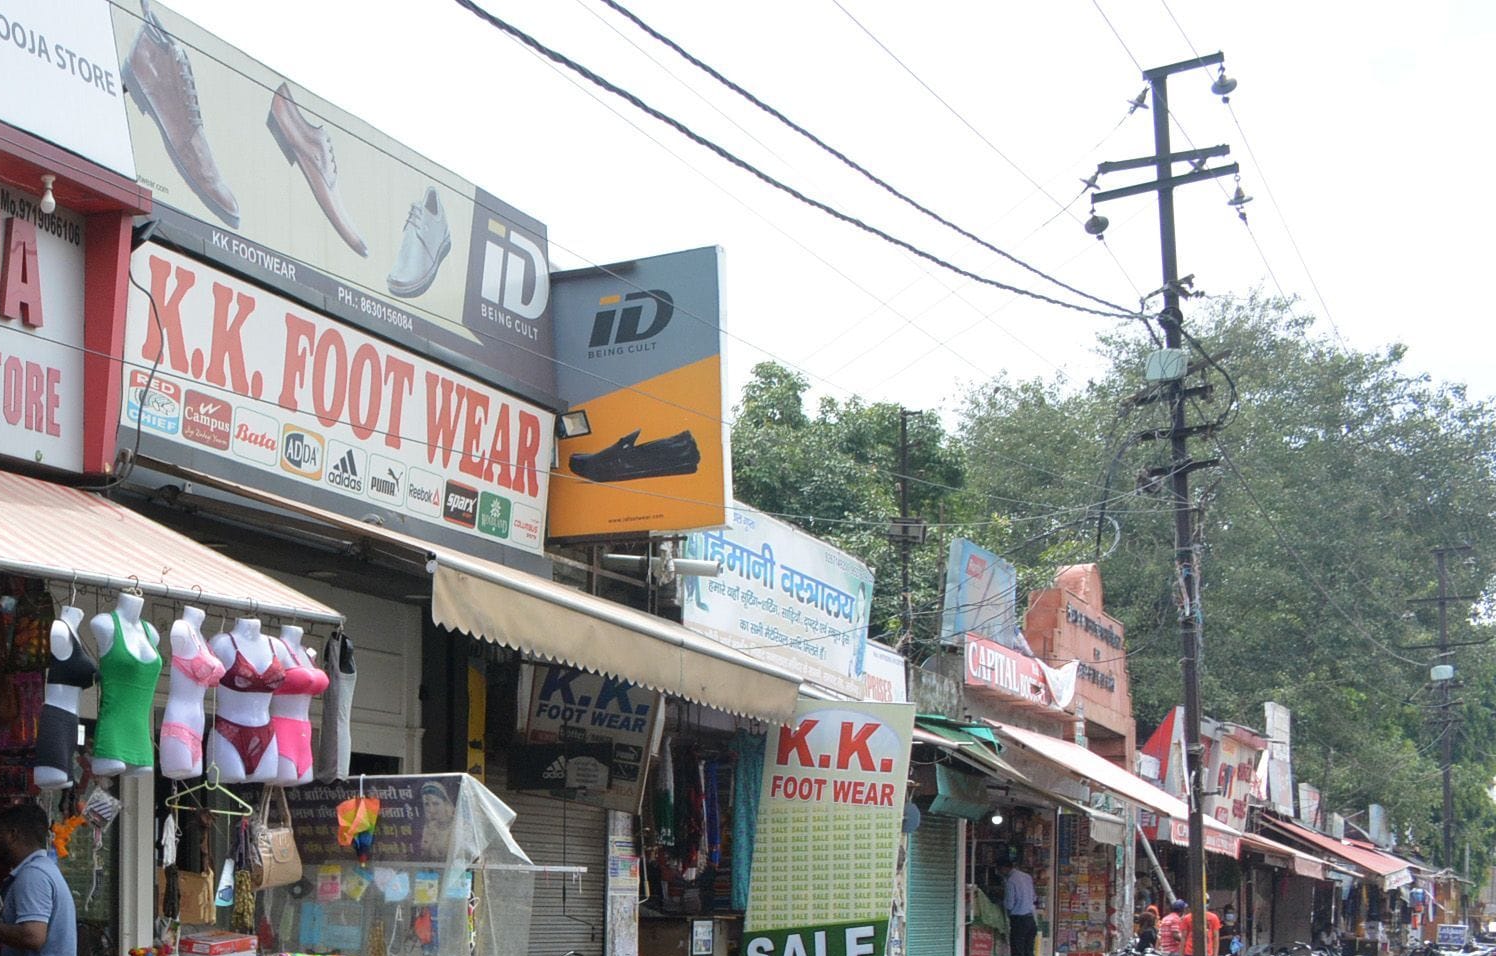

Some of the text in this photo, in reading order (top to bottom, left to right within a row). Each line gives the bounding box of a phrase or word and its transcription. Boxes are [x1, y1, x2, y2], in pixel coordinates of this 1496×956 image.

[56, 44, 117, 97] STORE
[212, 231, 296, 281] KK FOOTWEAR
[361, 296, 413, 332] 8630156084
[481, 303, 539, 340] BEING CULT
[588, 342, 657, 360] BEING CULT
[136, 373, 175, 395] RED
[142, 254, 540, 497] K.K. FOOT WEAR
[128, 408, 177, 432] CHIEF
[185, 406, 230, 433] Campus
[235, 423, 276, 452] Bata
[286, 436, 317, 467] ADDA
[328, 471, 362, 492] adidas
[371, 476, 396, 496] PUMA
[409, 484, 433, 504] Reebok
[446, 493, 477, 514] sparx
[780, 564, 856, 623] वस्त्रालय
[969, 641, 1020, 693] CAPITAL
[536, 702, 647, 733] FOOT WEAR
[776, 719, 894, 773] K.K.
[771, 775, 895, 807] FOOT WEAR
